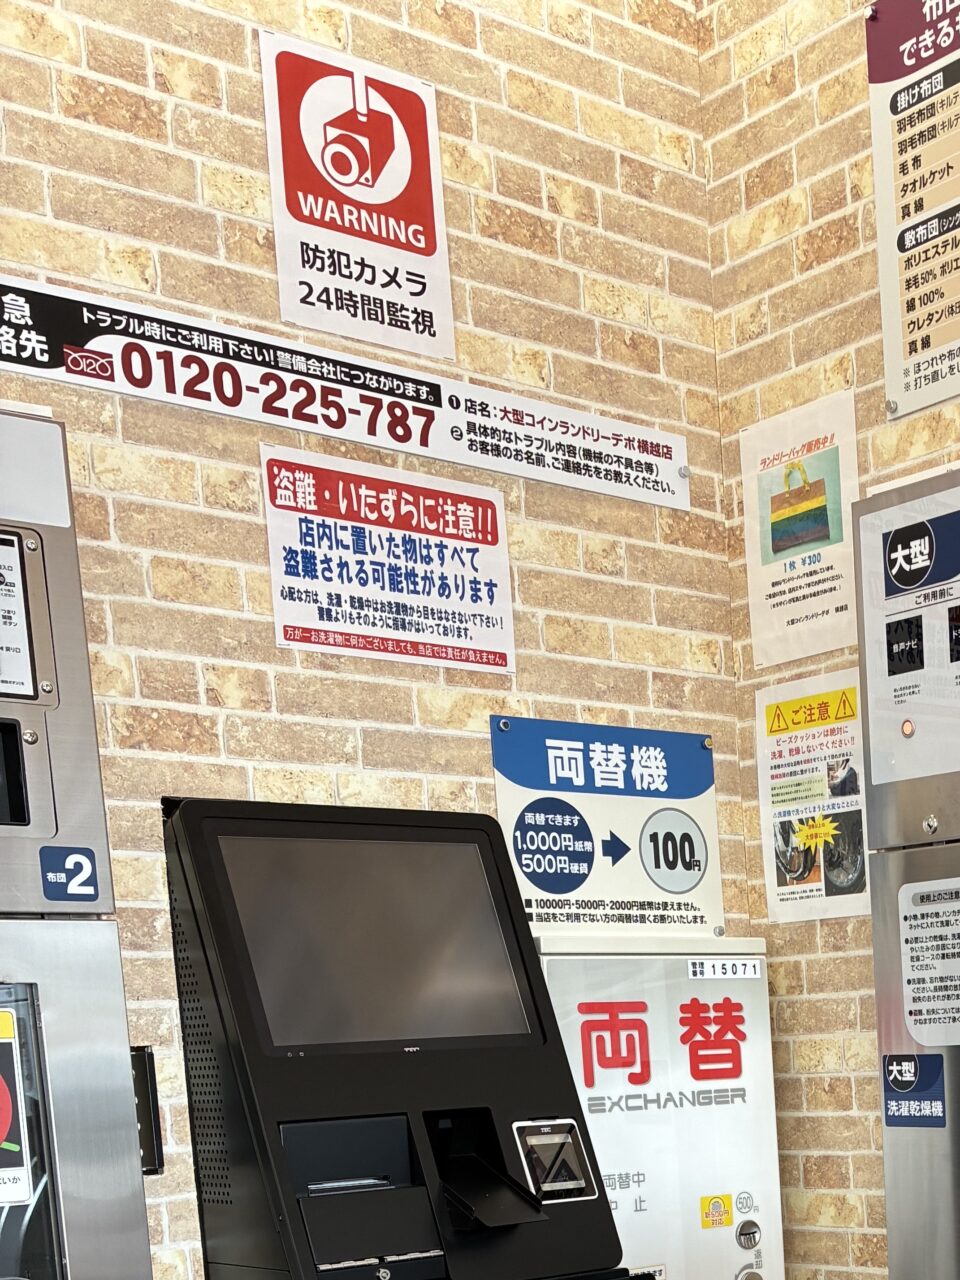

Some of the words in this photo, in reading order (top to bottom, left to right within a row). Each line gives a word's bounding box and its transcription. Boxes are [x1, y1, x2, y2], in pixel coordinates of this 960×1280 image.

[896, 72, 944, 112] 掛け布団
[899, 157, 922, 175] 毛布
[900, 162, 954, 197] タオルケット
[297, 189, 426, 249] WARNING
[900, 197, 925, 220] 真綿
[300, 241, 428, 298] 防犯カメラ
[2, 293, 33, 326] 急
[298, 280, 436, 338] 24時間監視
[909, 334, 931, 356] 真綿
[121, 341, 436, 448] 0120-225-787
[298, 516, 480, 573] 店内に置いた物はすべて
[889, 536, 931, 576] 大型
[283, 546, 498, 606] 盗難される可能性があります
[915, 587, 954, 605] ご利用前に
[893, 638, 918, 653] 音声ナビ
[791, 700, 831, 726] ご注意
[545, 738, 669, 792] 両替機
[524, 812, 581, 827] 両替できます
[514, 830, 593, 853] 1,000円紙幣
[47, 871, 66, 883] 布団
[65, 854, 95, 894] 2
[521, 853, 589, 875] 500円硬貨
[920, 890, 960, 903] 使用上のご注意
[577, 996, 747, 1088] 両替
[888, 1061, 916, 1081] 大型
[587, 1087, 747, 1114] EXCHANGER
[887, 1100, 944, 1118] 洗濯乾燥機
